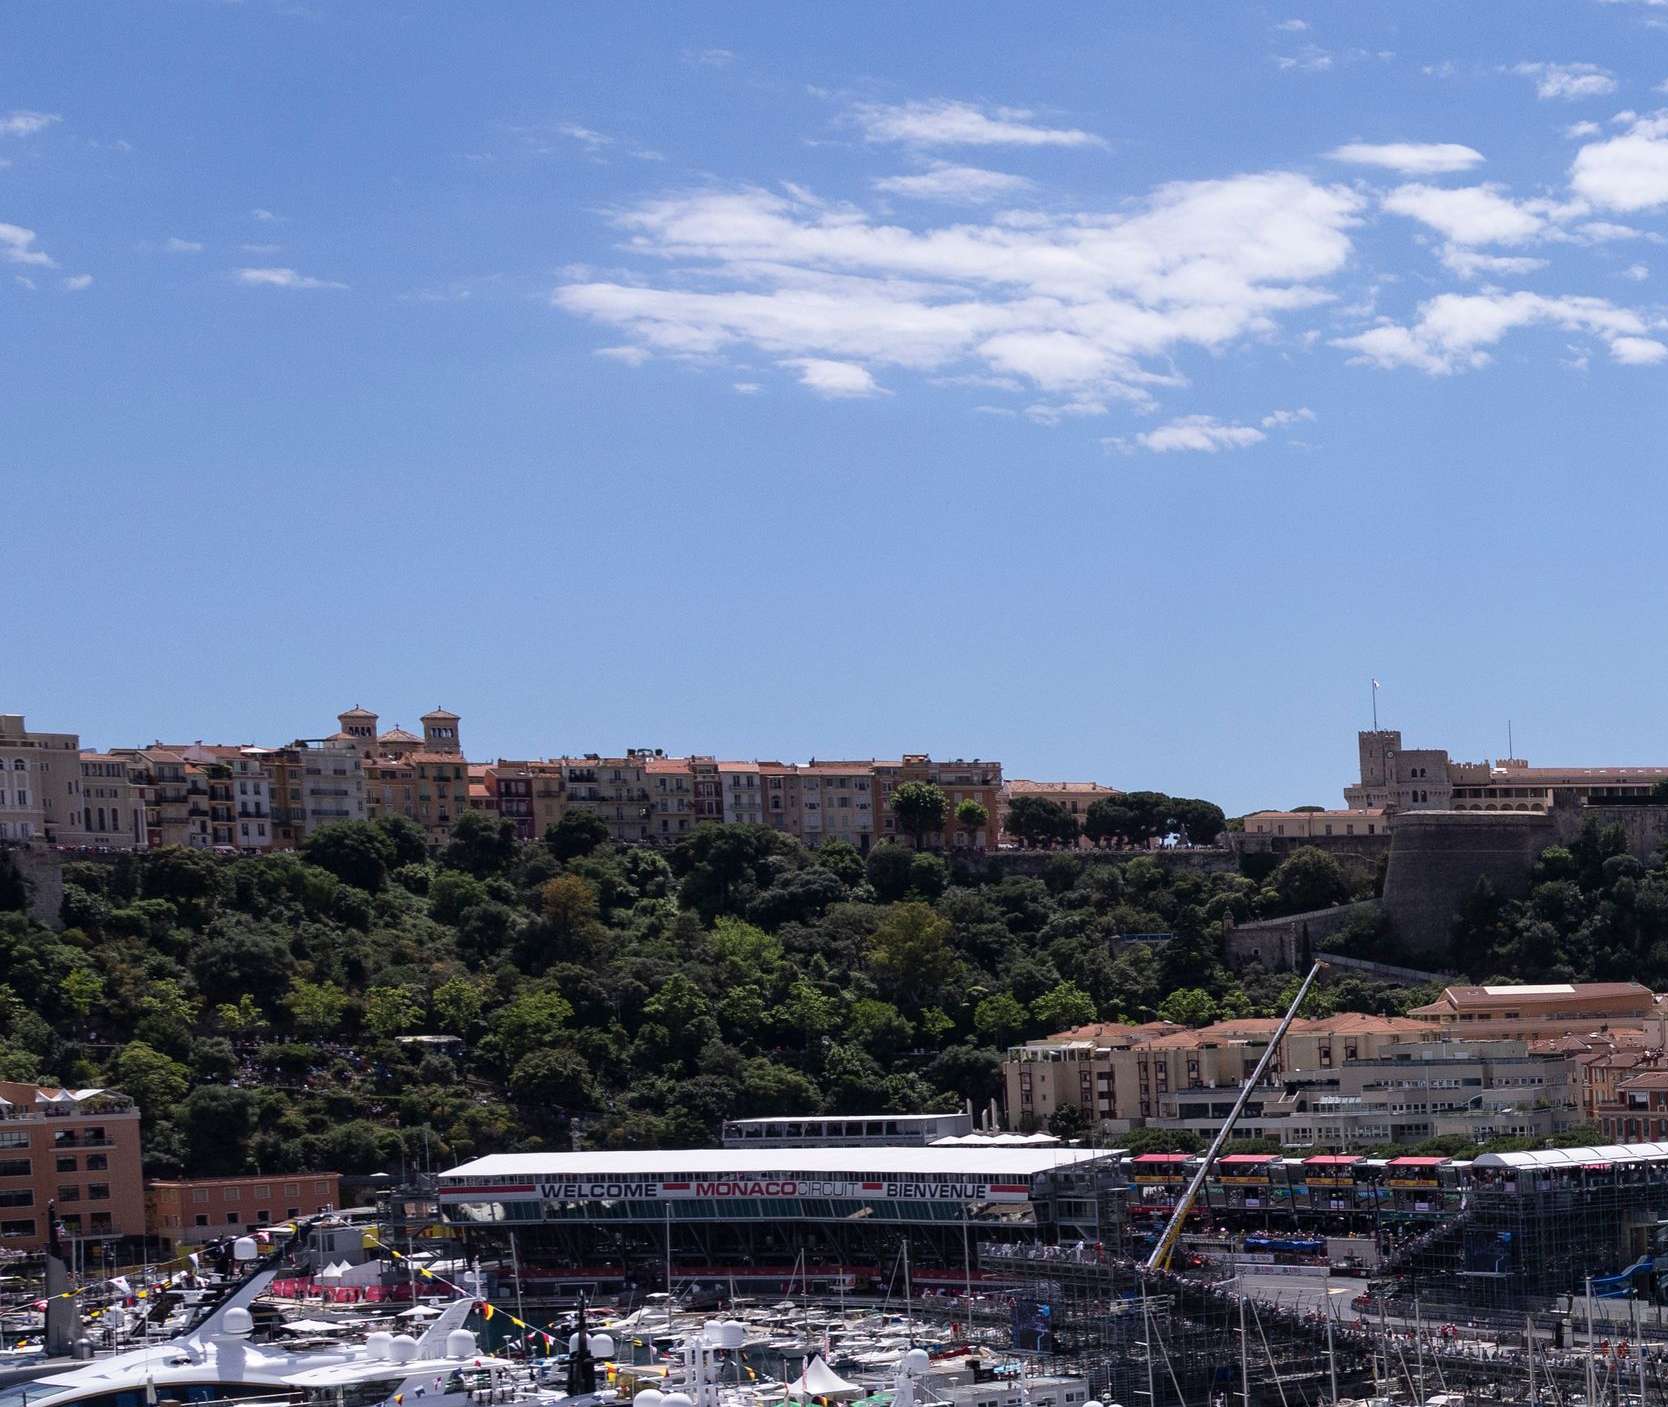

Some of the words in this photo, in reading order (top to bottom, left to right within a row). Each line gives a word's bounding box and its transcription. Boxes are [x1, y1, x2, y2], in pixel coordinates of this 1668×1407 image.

[540, 1183, 657, 1198] WELCOME
[696, 1182, 797, 1196] MONACO
[798, 1182, 858, 1196] CIRCUIT
[887, 1184, 986, 1198] BIENVENUE
